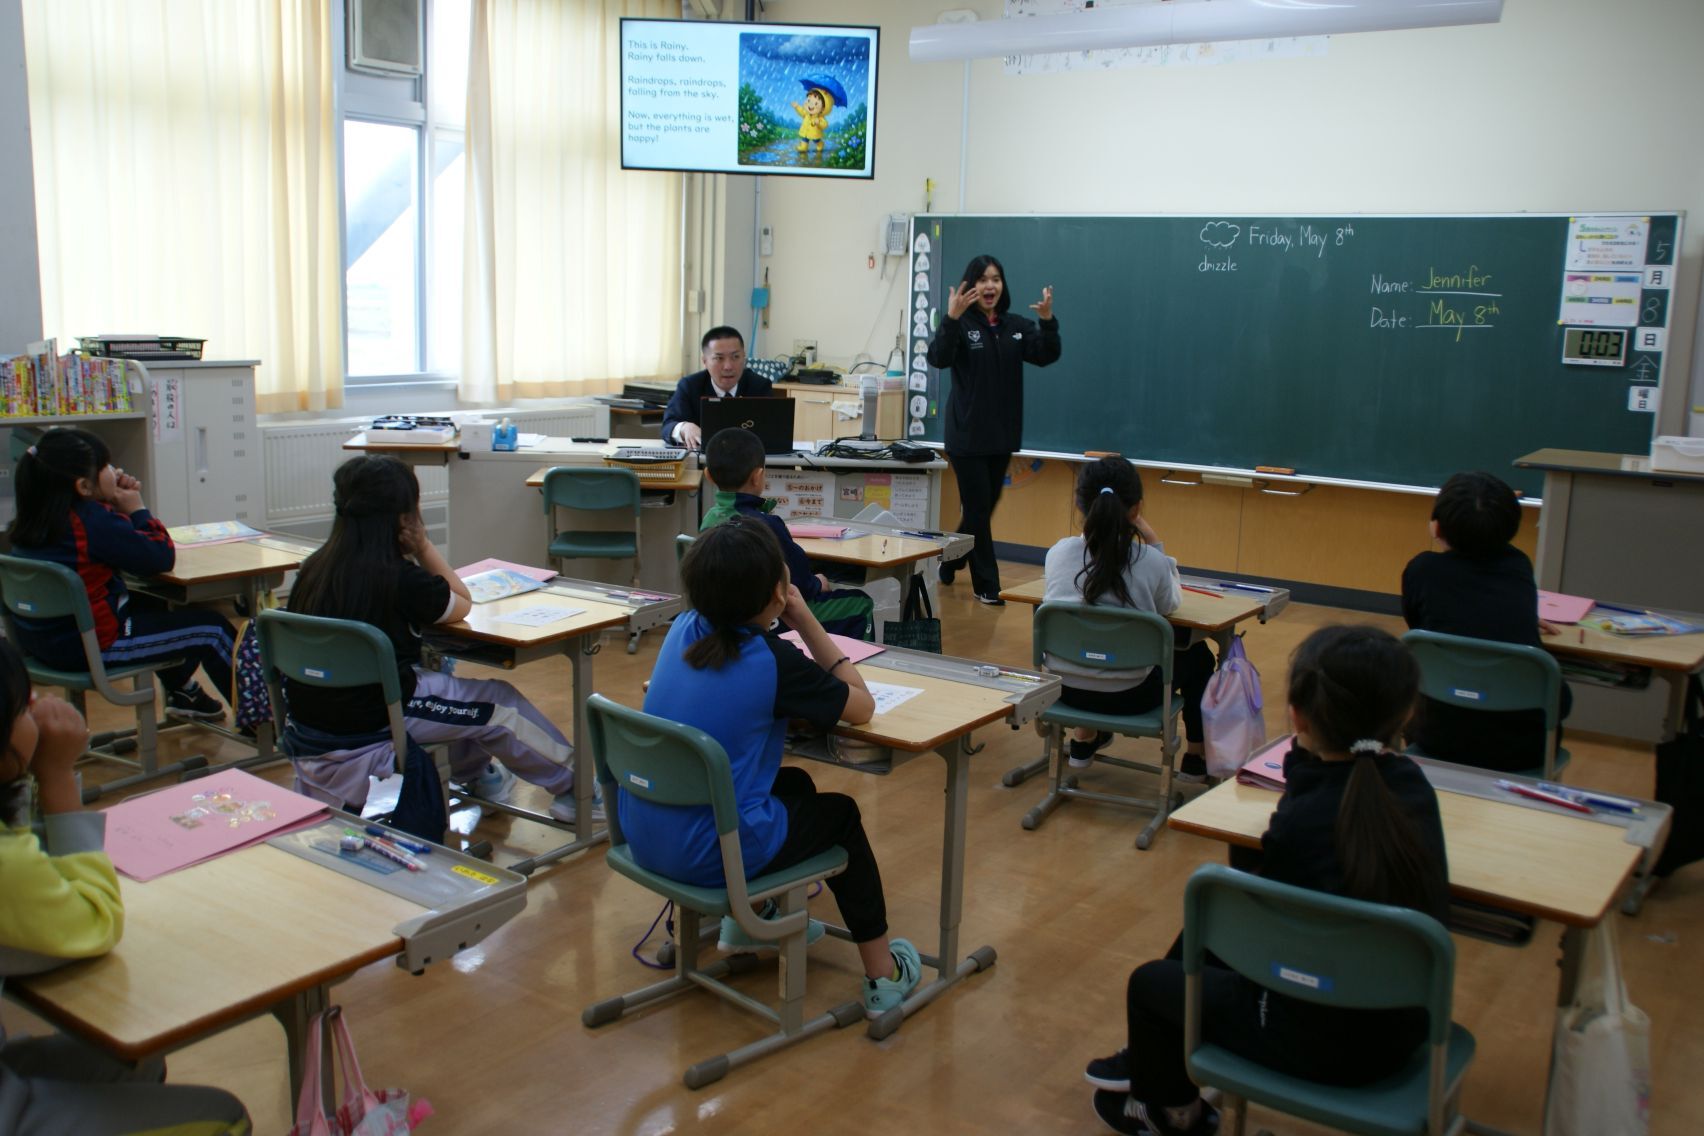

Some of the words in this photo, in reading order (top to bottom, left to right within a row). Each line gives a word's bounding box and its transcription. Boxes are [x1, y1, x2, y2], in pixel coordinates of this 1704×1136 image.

[628, 40, 647, 49] This
[650, 41, 658, 49] is
[660, 41, 689, 51] Rainy.
[628, 52, 653, 62] Rainy
[656, 53, 676, 62] falls
[678, 54, 706, 63] down.
[628, 75, 677, 86] Raindrops,
[680, 77, 726, 88] raindrops,
[628, 87, 657, 98] falling
[660, 88, 680, 97] from
[684, 89, 698, 97] the
[701, 90, 719, 100] sky.
[628, 111, 650, 120] Now,
[653, 112, 702, 123] everything
[704, 113, 712, 121] is
[715, 114, 735, 123] wet,
[628, 123, 643, 131] but
[646, 123, 661, 131] the
[664, 123, 692, 133] plants
[695, 125, 710, 133] are
[628, 134, 659, 144] happy!
[1249, 225, 1294, 253] Friday,
[1300, 225, 1328, 258] May
[1335, 223, 1354, 246] 8th
[1198, 254, 1239, 272] drizzle
[1370, 273, 1414, 294] Name:
[1422, 264, 1493, 289] Jennifer
[1650, 270, 1663, 286] 月
[1642, 297, 1661, 323] 8
[1370, 306, 1412, 329] Date:
[1429, 299, 1465, 342] May
[1474, 301, 1500, 325] 8th
[1644, 333, 1656, 346] 日
[425, 700, 448, 714] enjoy
